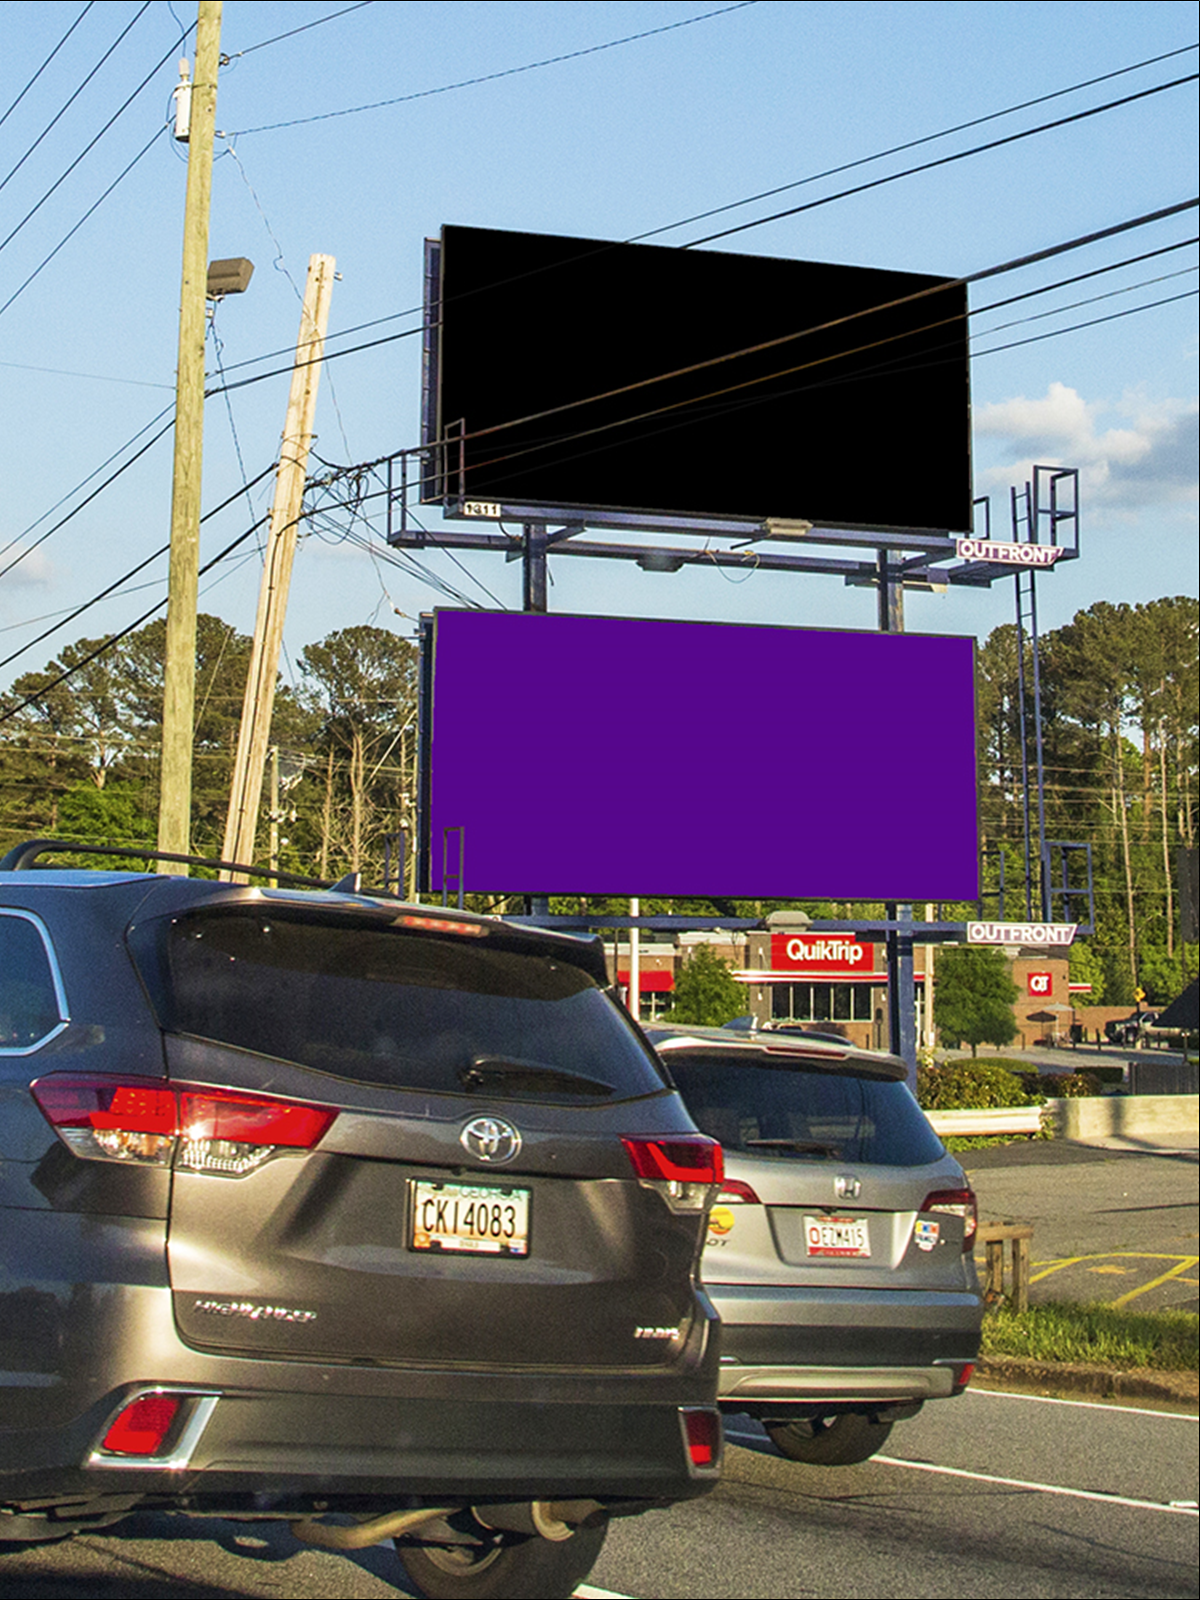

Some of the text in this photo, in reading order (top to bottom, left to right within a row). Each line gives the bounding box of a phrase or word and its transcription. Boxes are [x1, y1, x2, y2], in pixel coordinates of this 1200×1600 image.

[960, 541, 1057, 564] OUTFRONT
[971, 924, 1070, 941] OUTFRONT
[786, 938, 864, 965] QuikTrip
[1030, 976, 1049, 992] QT
[460, 1188, 522, 1202] GEORA
